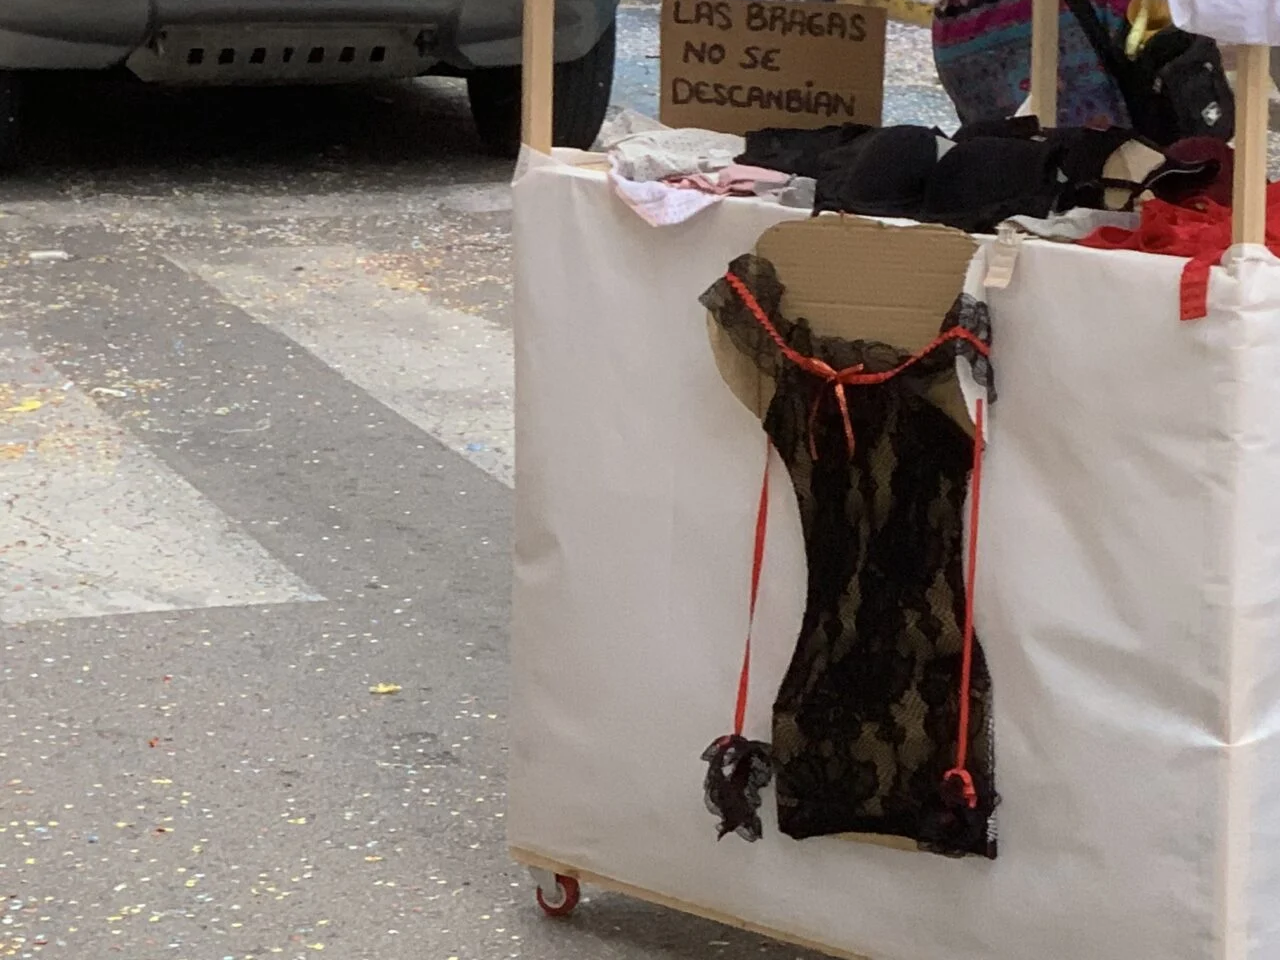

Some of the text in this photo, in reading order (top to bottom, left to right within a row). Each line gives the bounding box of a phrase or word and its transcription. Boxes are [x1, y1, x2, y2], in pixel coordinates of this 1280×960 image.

[673, 0, 867, 42] LAS BRAGAS
[682, 40, 781, 71] NO SE
